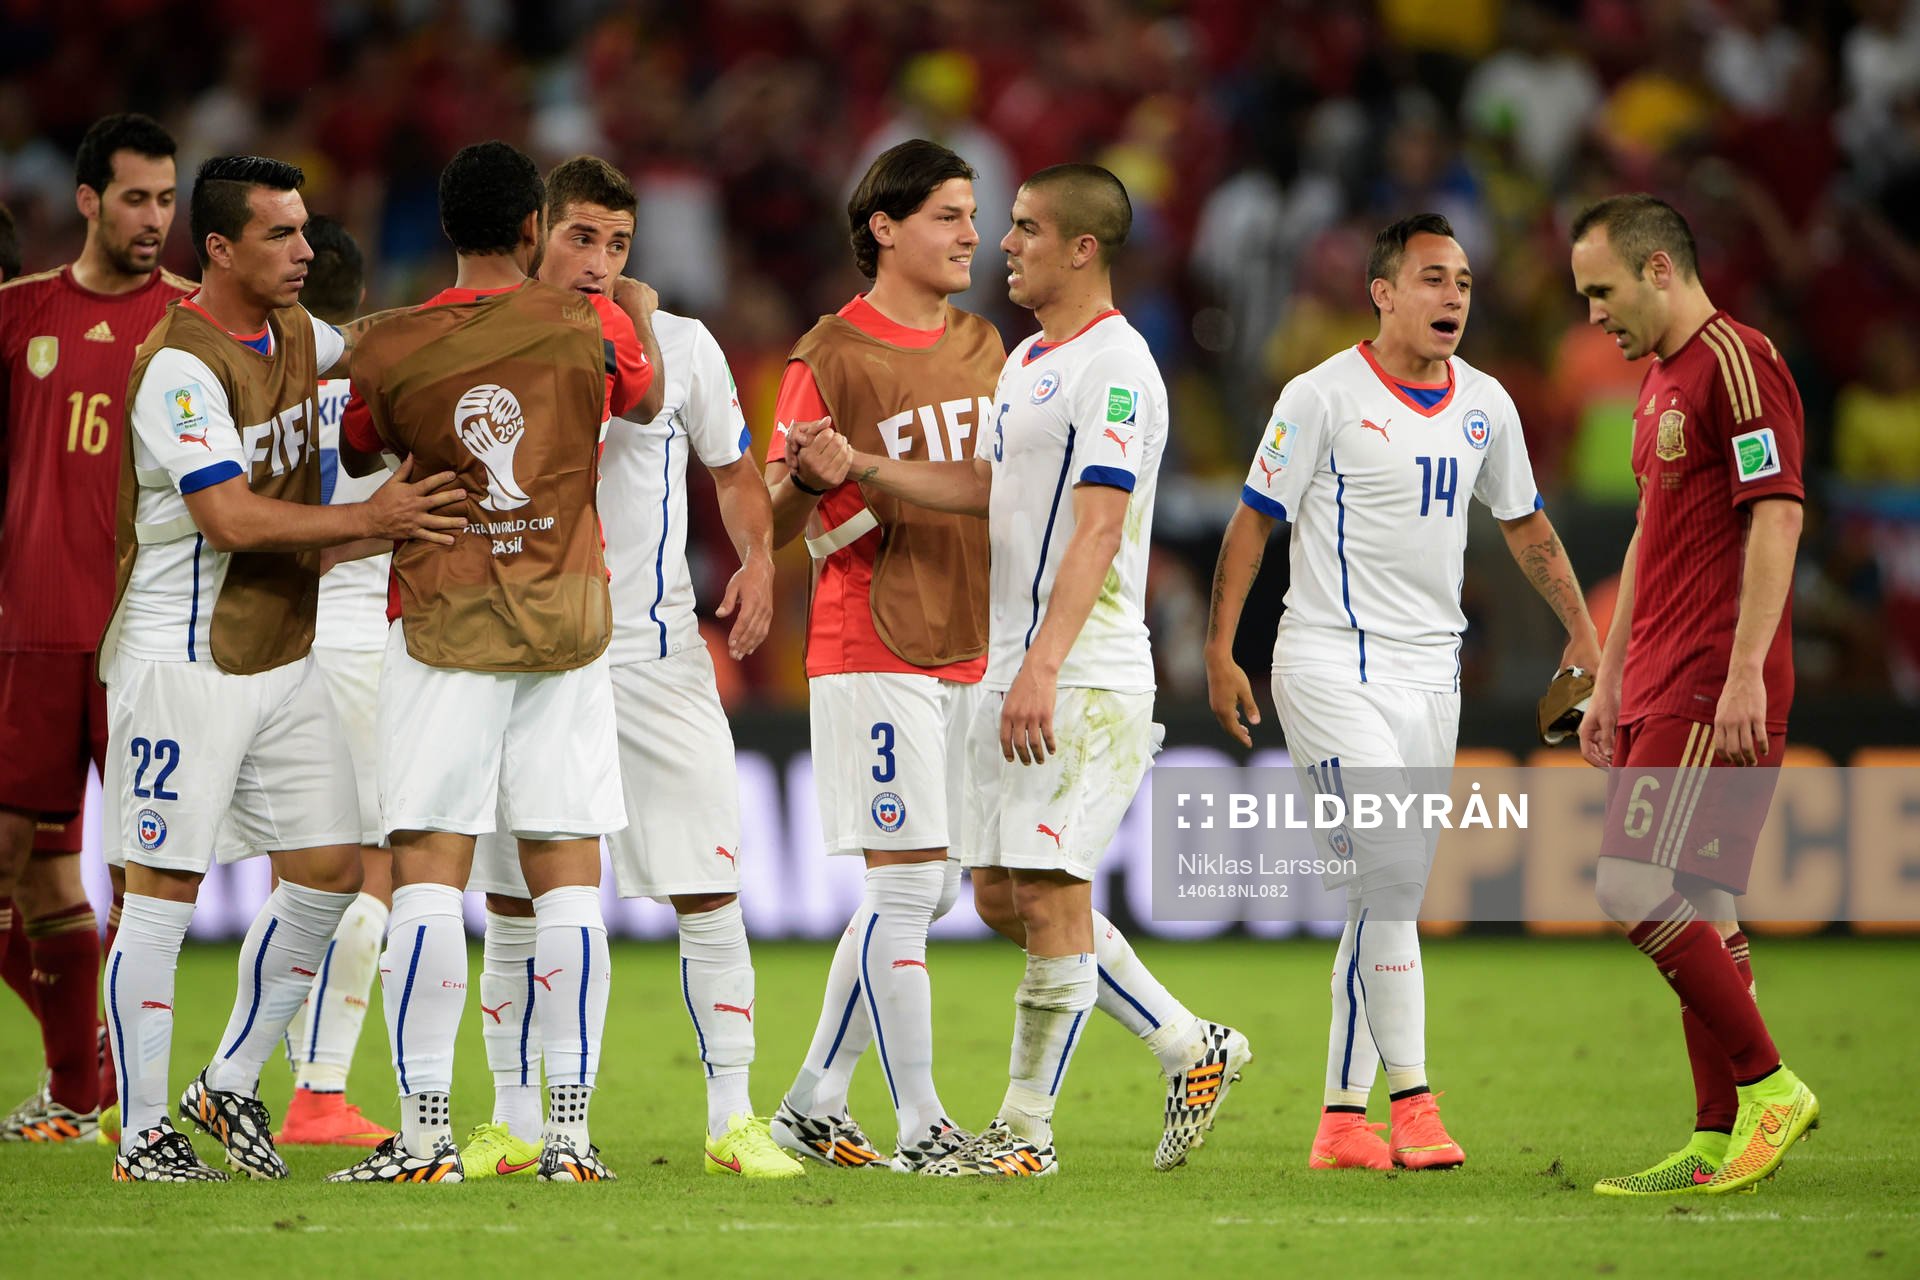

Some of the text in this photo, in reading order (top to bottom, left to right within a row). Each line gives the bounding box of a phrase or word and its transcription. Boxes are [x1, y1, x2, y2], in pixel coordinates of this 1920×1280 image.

[67, 391, 112, 455] 16
[495, 415, 525, 442] 2014
[994, 403, 1010, 462] 5
[1415, 456, 1458, 517] 14
[489, 520, 527, 535] WORLD
[529, 517, 555, 531] CUP
[131, 737, 180, 800] 22
[871, 722, 896, 783] 3
[1624, 776, 1661, 839] 6
[1375, 960, 1416, 972] CHILE
